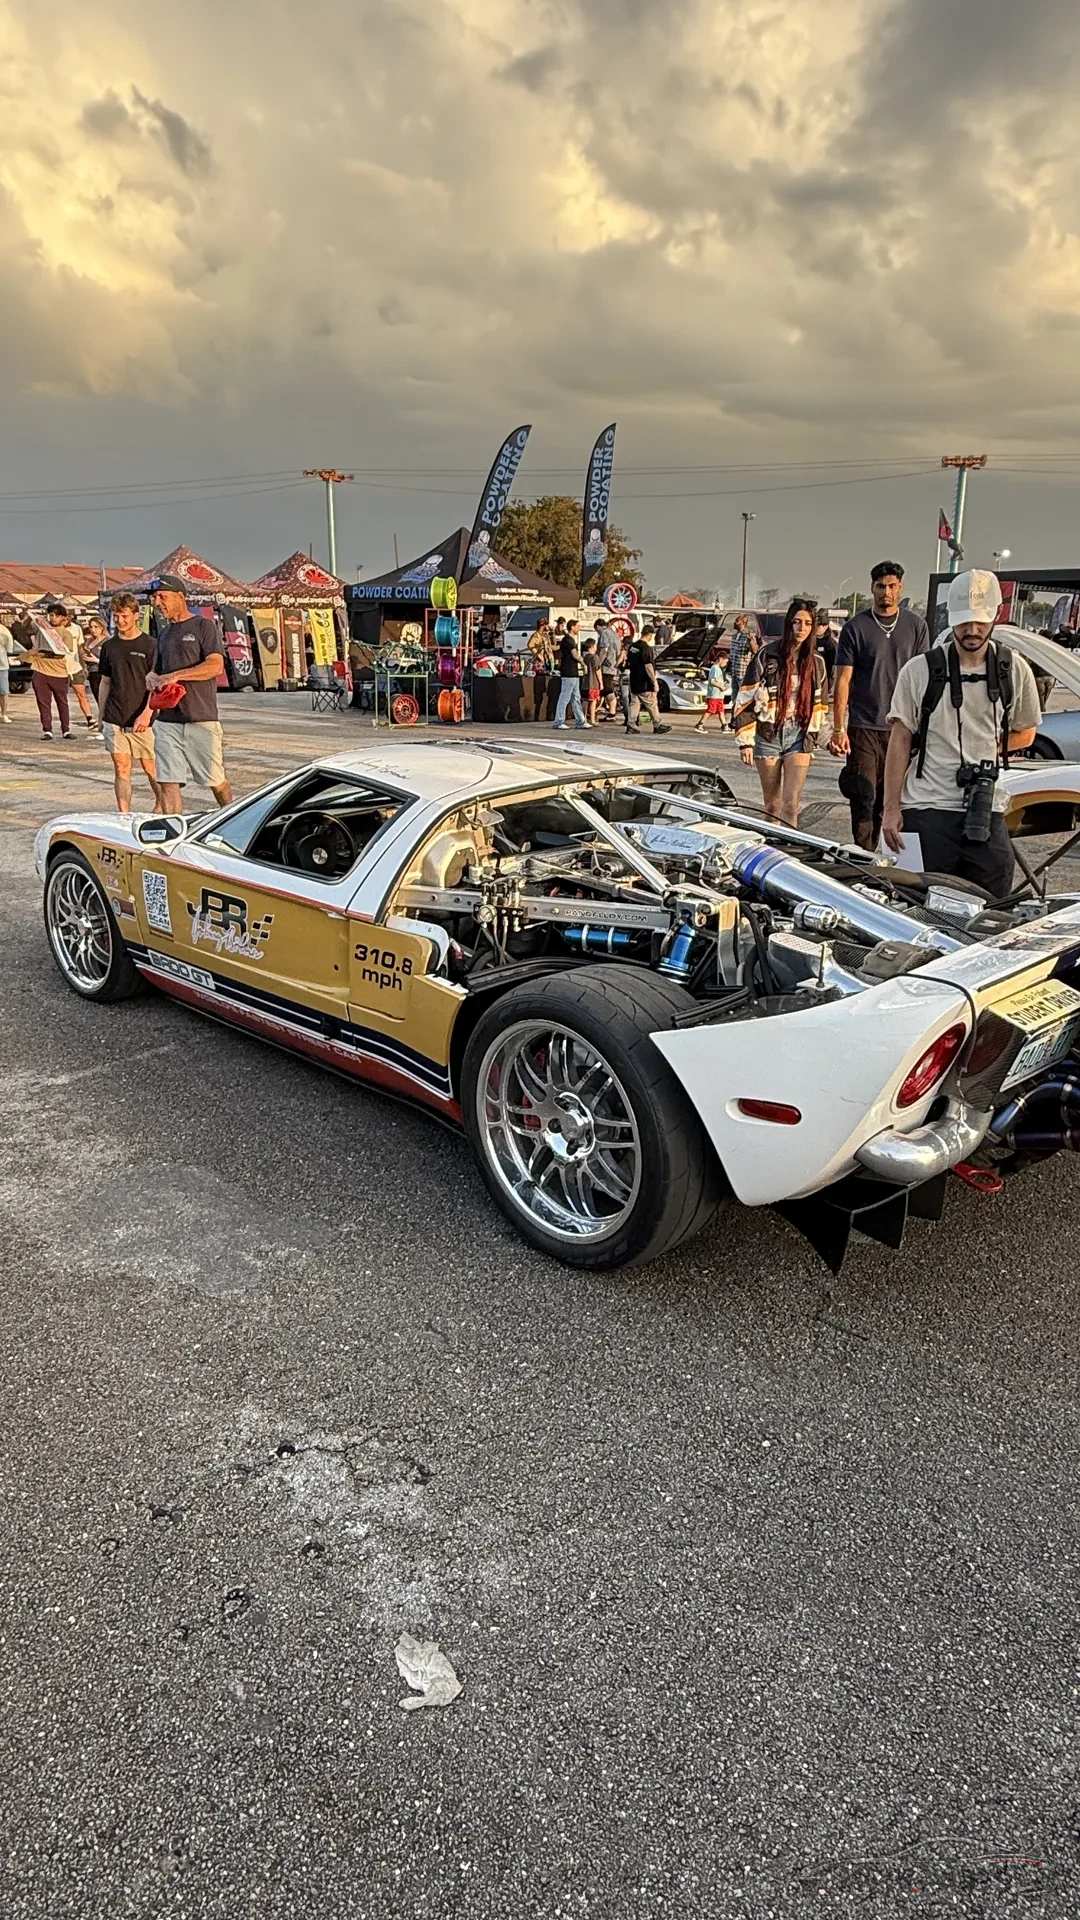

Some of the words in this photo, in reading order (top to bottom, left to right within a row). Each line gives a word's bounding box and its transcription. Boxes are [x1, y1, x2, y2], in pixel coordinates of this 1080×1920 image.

[481, 443, 513, 524] POWDER
[491, 430, 528, 527] COATING
[589, 447, 604, 522] POWDER
[598, 429, 615, 522] COATING
[352, 586, 393, 599] POWDER
[148, 913, 170, 928] SCAN
[354, 944, 413, 976] 310.8
[190, 968, 211, 986] GT
[362, 967, 403, 992] mph
[1006, 1001, 1057, 1026] STUDENT
[286, 1028, 332, 1052] STREET
[332, 1046, 363, 1064] CAR
